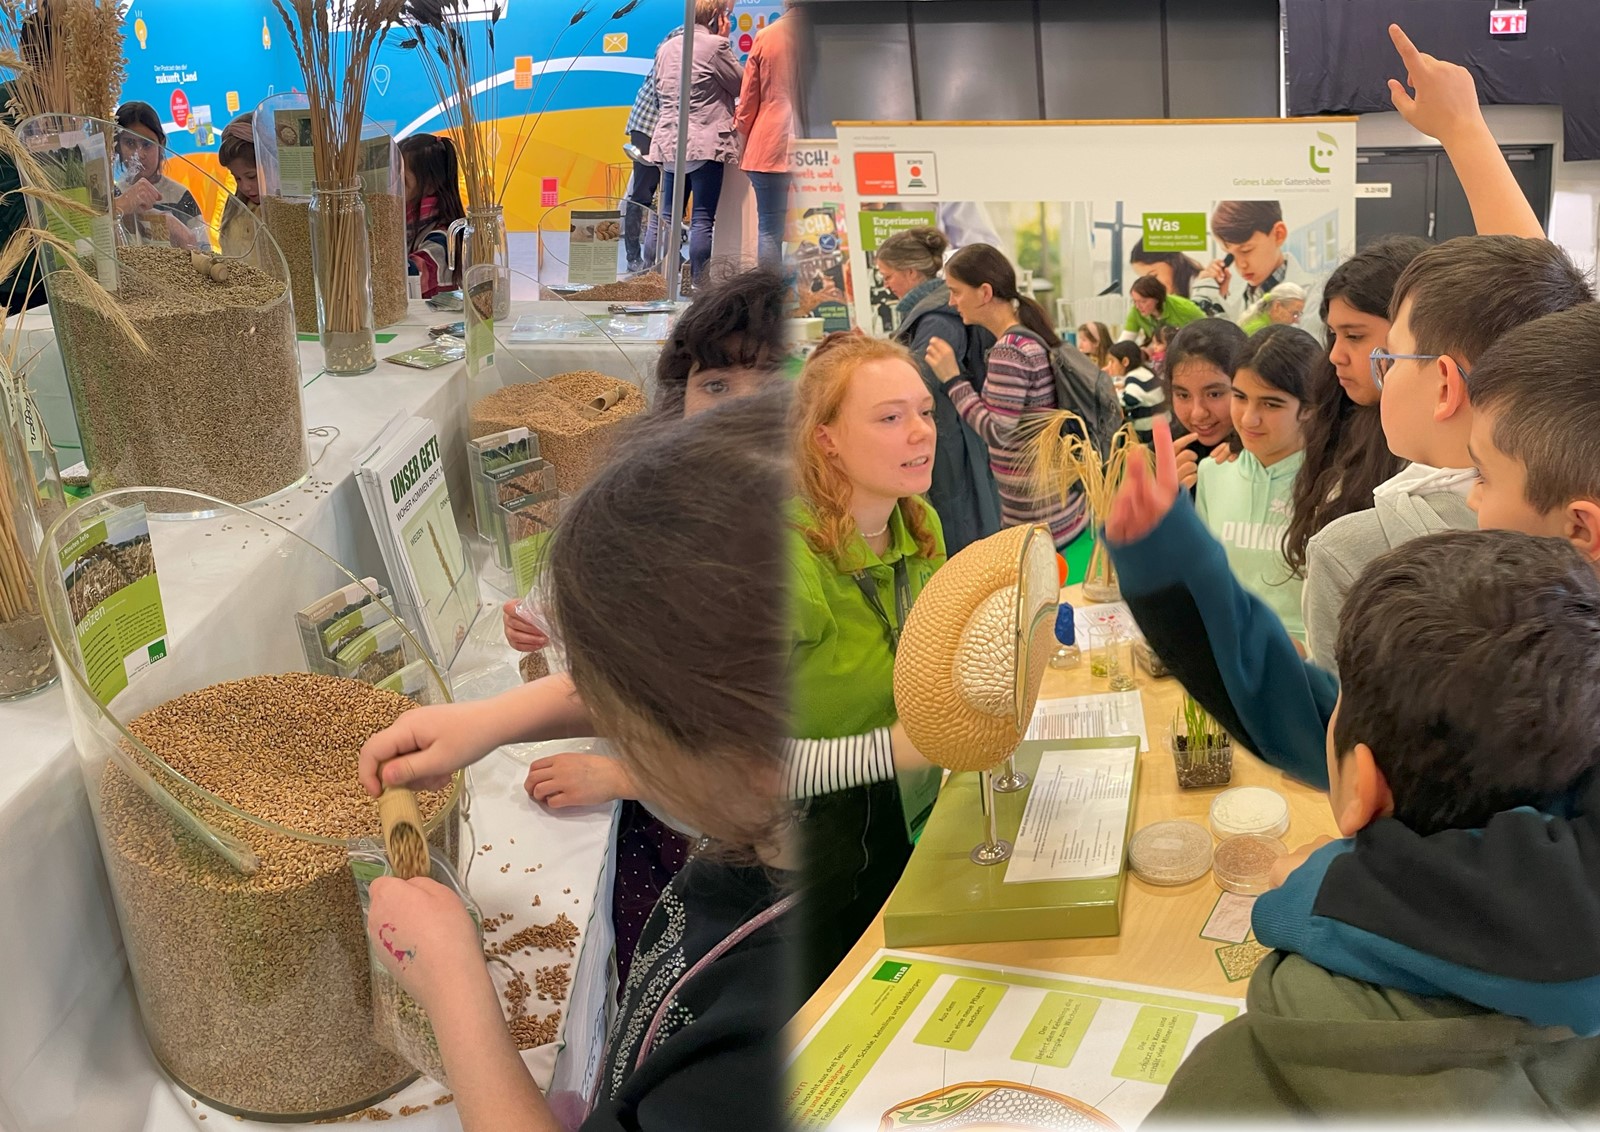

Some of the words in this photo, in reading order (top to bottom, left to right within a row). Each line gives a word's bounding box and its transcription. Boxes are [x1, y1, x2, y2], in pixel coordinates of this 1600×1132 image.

[1233, 178, 1260, 186] Grünes
[1262, 178, 1283, 186] Labor
[1284, 178, 1331, 186] Gatersleben
[872, 216, 929, 228] Experimente
[874, 227, 887, 236] für
[1146, 218, 1180, 232] Was
[390, 454, 421, 504] UNSER
[396, 499, 412, 522] WOHER
[410, 482, 430, 506] KOMMEN
[64, 538, 80, 558] Minuten
[79, 532, 90, 544] Info
[410, 526, 424, 546] WEIZEN
[76, 604, 106, 638] Weizen
[938, 1010, 949, 1023] Aus
[946, 1000, 957, 1014] dem
[944, 1030, 957, 1044] kann
[954, 1017, 966, 1032] eine
[962, 1005, 974, 1019] neue
[972, 986, 987, 1006] Pflanze
[966, 1004, 985, 1028] wachsen.
[1038, 1024, 1048, 1035] Der
[1046, 1037, 1063, 1060] Energie
[1059, 1023, 1070, 1038] zum
[1152, 1027, 1163, 1041] Korn
[812, 1096, 832, 1118] Karten
[830, 1086, 840, 1098] mit
[836, 1069, 854, 1086] Teilen
[851, 1058, 862, 1070] von
[858, 1039, 878, 1059] Schale,
[873, 1016, 895, 1039] Keimling
[892, 1005, 902, 1018] und
[898, 978, 922, 1007] Mehlkörper
[799, 1083, 820, 1106] besteht
[818, 1072, 829, 1084] aus
[826, 1062, 838, 1074] drei
[810, 1096, 822, 1109] und
[818, 1064, 846, 1098] Mehlkörper
[821, 1098, 842, 1121] Feldern
[840, 1088, 850, 1099] zu!
